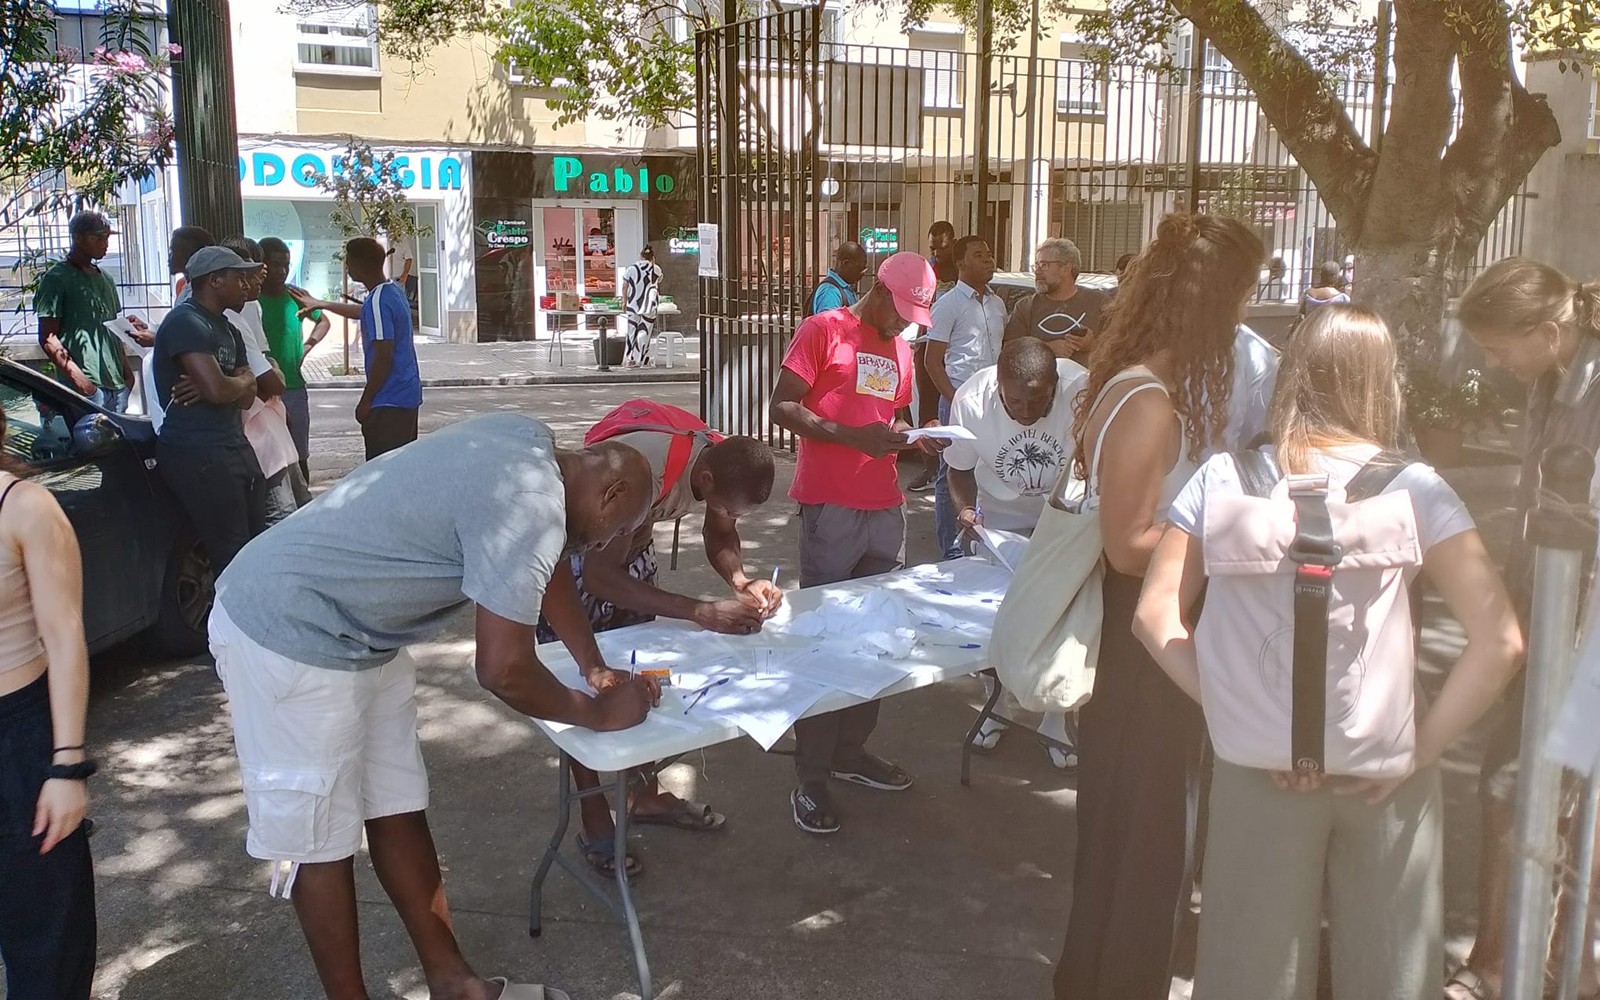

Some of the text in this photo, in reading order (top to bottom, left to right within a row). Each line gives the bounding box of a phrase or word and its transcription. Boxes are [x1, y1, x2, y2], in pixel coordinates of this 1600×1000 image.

[552, 156, 675, 193] Pablo
[486, 231, 529, 245] Crespo
[496, 224, 528, 236] Pablo
[1008, 427, 1038, 447] HOTEL
